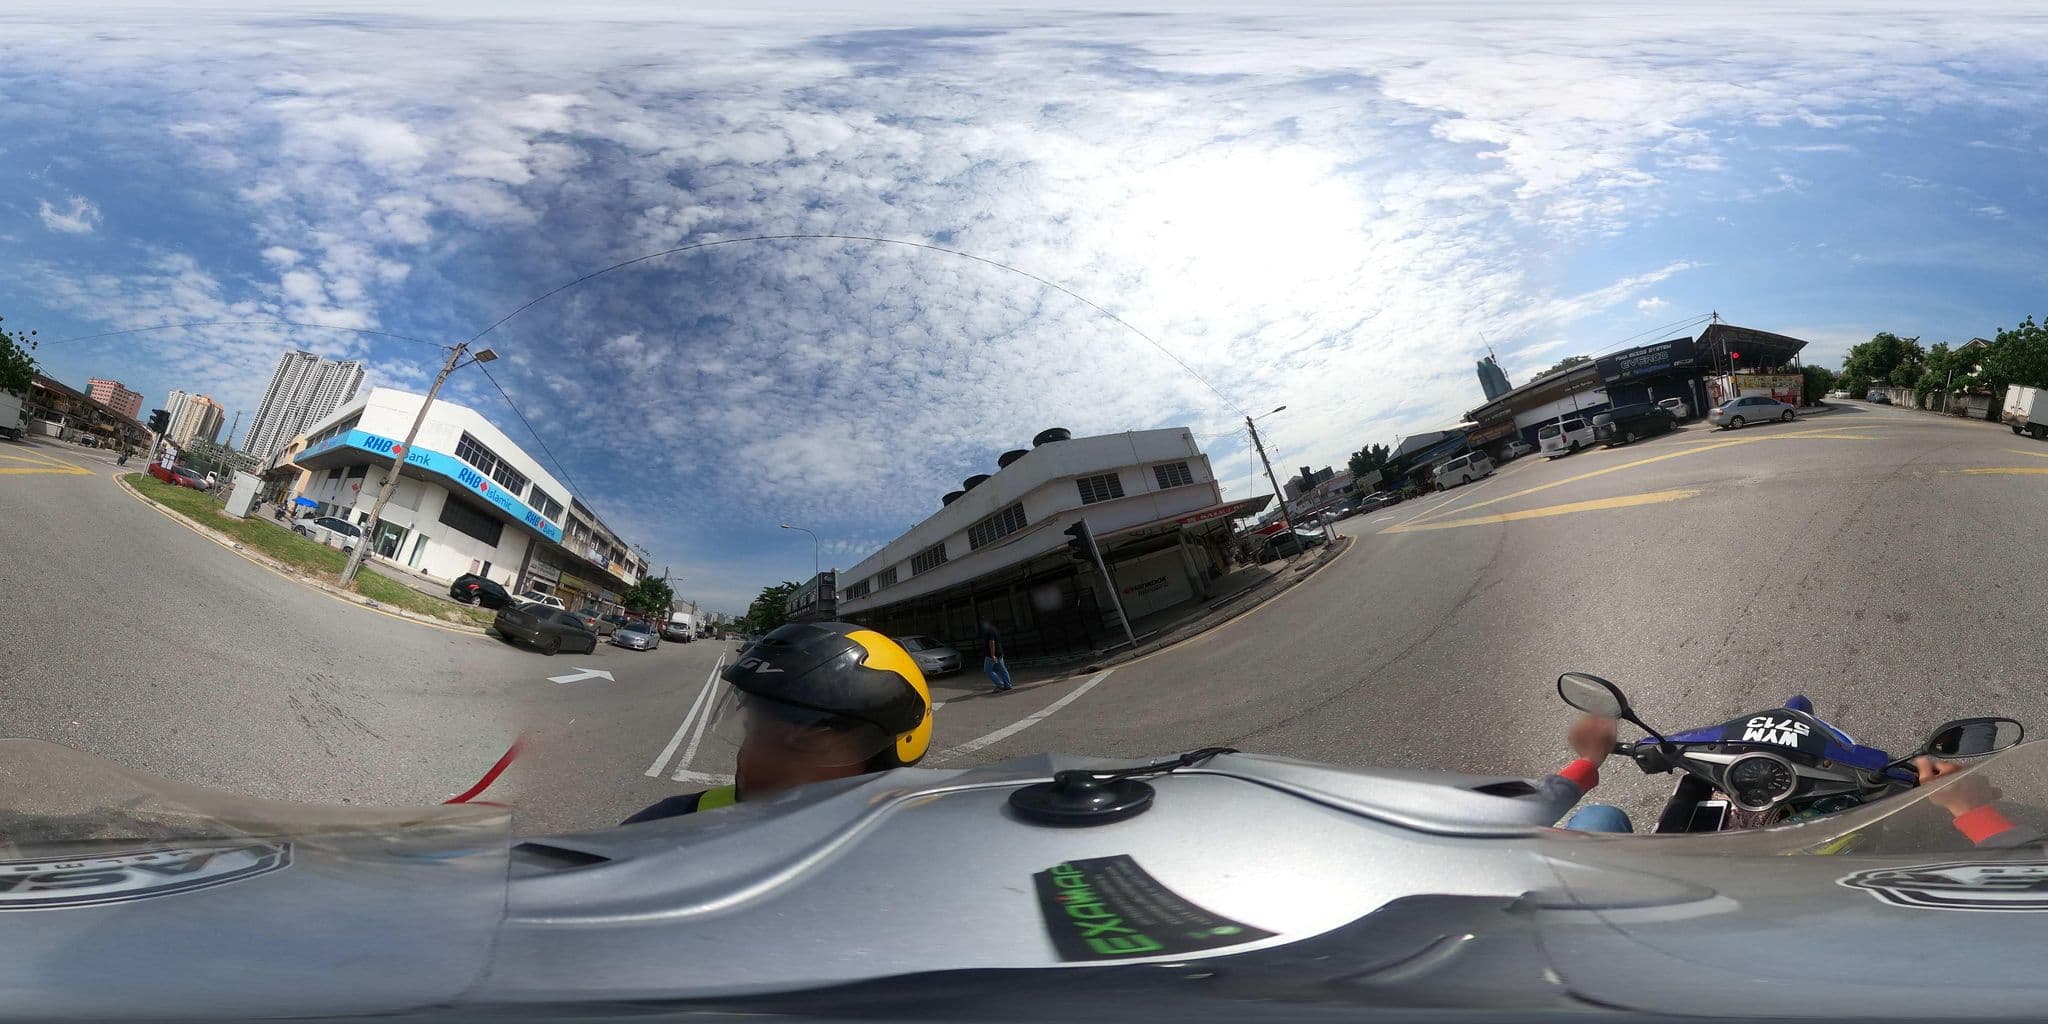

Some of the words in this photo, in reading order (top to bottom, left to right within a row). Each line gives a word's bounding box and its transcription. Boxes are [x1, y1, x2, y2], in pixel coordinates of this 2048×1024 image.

[363, 435, 393, 453] RHB
[406, 447, 431, 466] ank
[458, 467, 482, 489] RHB
[486, 488, 513, 511] Islamic
[525, 511, 540, 527] RHB
[1746, 717, 1810, 737] 5713
[1742, 728, 1798, 748] WYM
